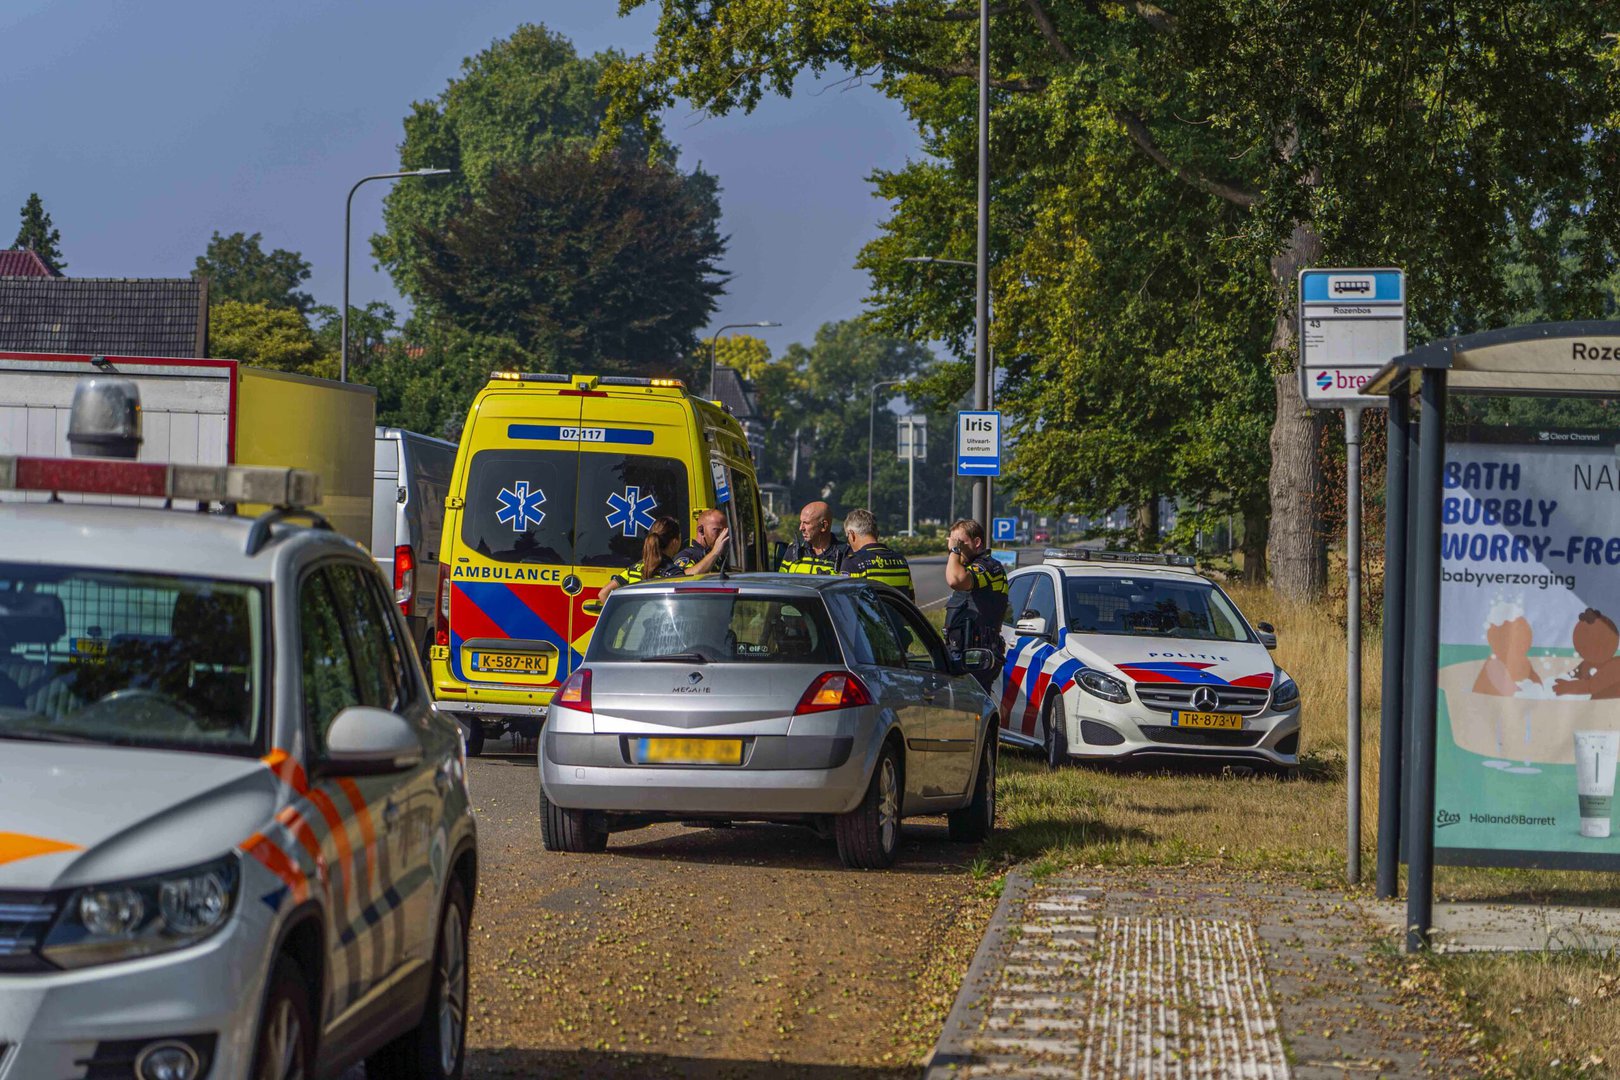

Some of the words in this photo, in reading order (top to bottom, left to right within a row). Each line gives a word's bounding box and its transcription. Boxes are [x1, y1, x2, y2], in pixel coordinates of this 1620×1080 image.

[1335, 369, 1373, 389] bre
[965, 418, 992, 432] Iris
[562, 429, 601, 440] 07-117
[1570, 433, 1600, 441] Channel
[1443, 461, 1520, 491] BATH
[1574, 464, 1620, 491] NA
[1442, 497, 1558, 527] BUBBLY
[453, 565, 561, 582] AMBULANCE
[1442, 567, 1576, 590] babyverzorging
[482, 655, 542, 670] K-587-RK
[1148, 652, 1230, 662] POLITIE
[1183, 713, 1237, 727] TR-873-V
[1436, 809, 1461, 828] Etos
[1469, 812, 1556, 826] Holland&Barrett
